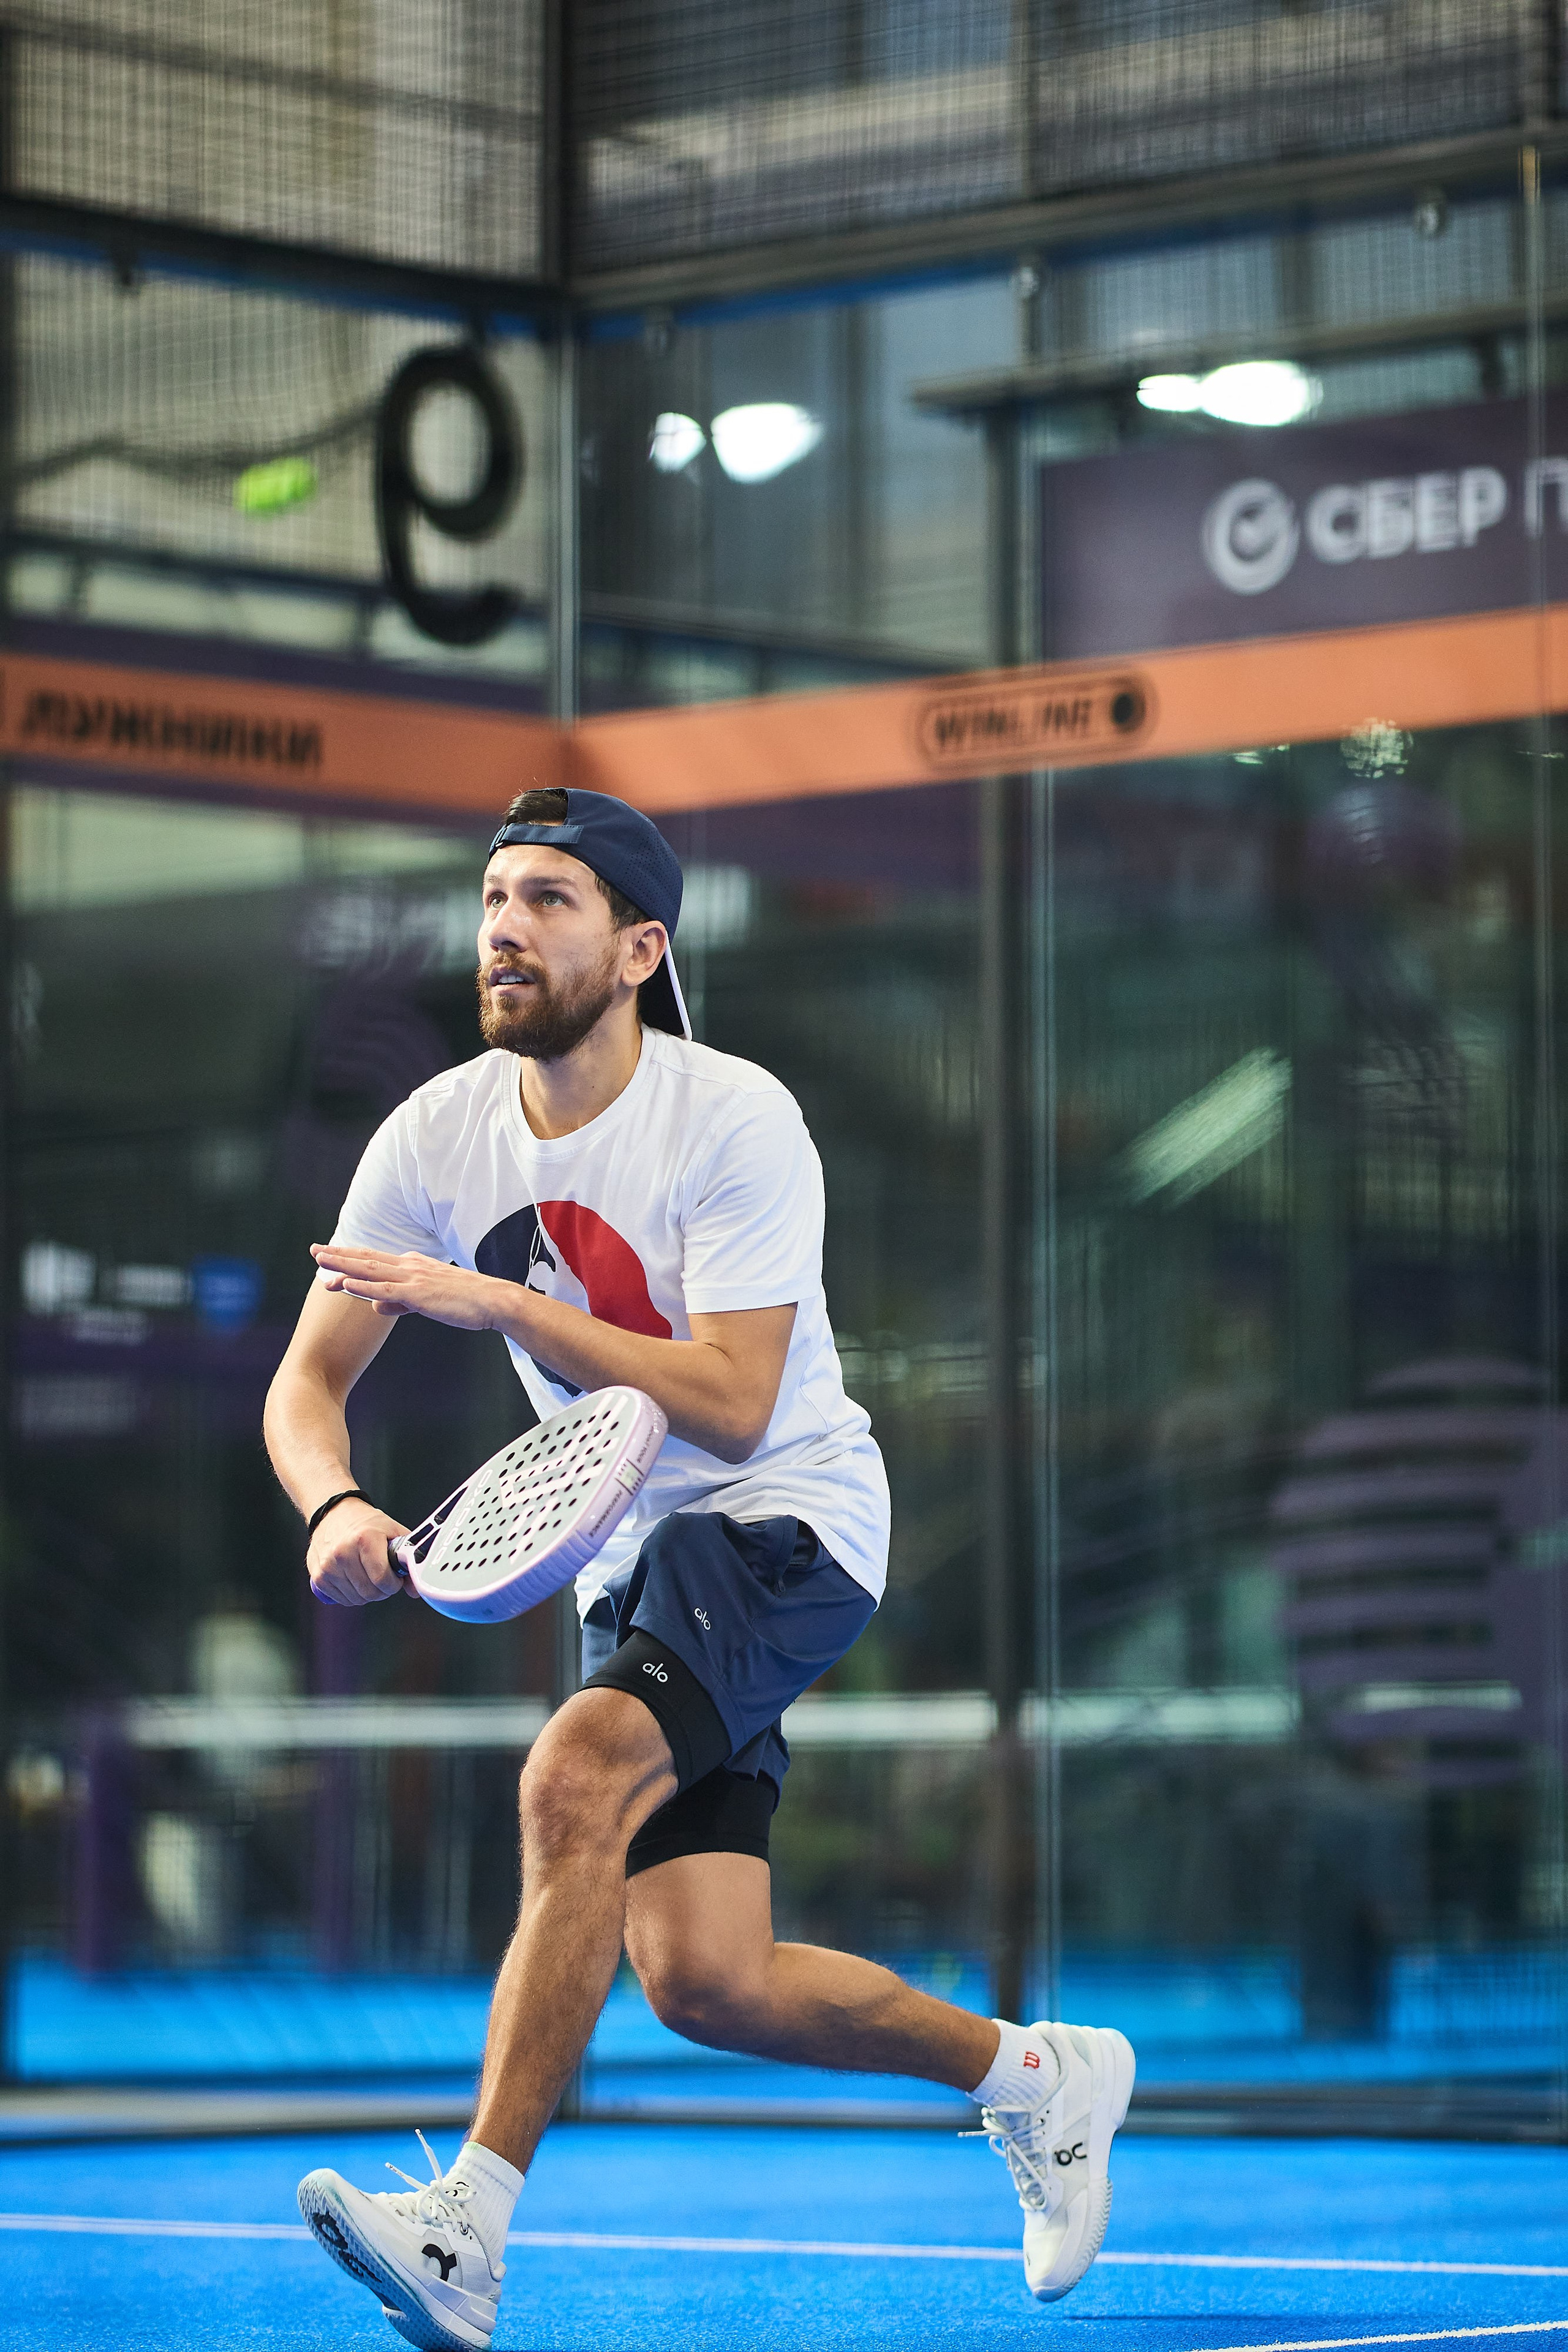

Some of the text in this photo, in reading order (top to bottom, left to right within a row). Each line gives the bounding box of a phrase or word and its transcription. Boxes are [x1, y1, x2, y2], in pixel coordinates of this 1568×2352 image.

[1305, 466, 1508, 566] СБЕР
[694, 1607, 712, 1630] alo
[642, 1662, 669, 1683] alo
